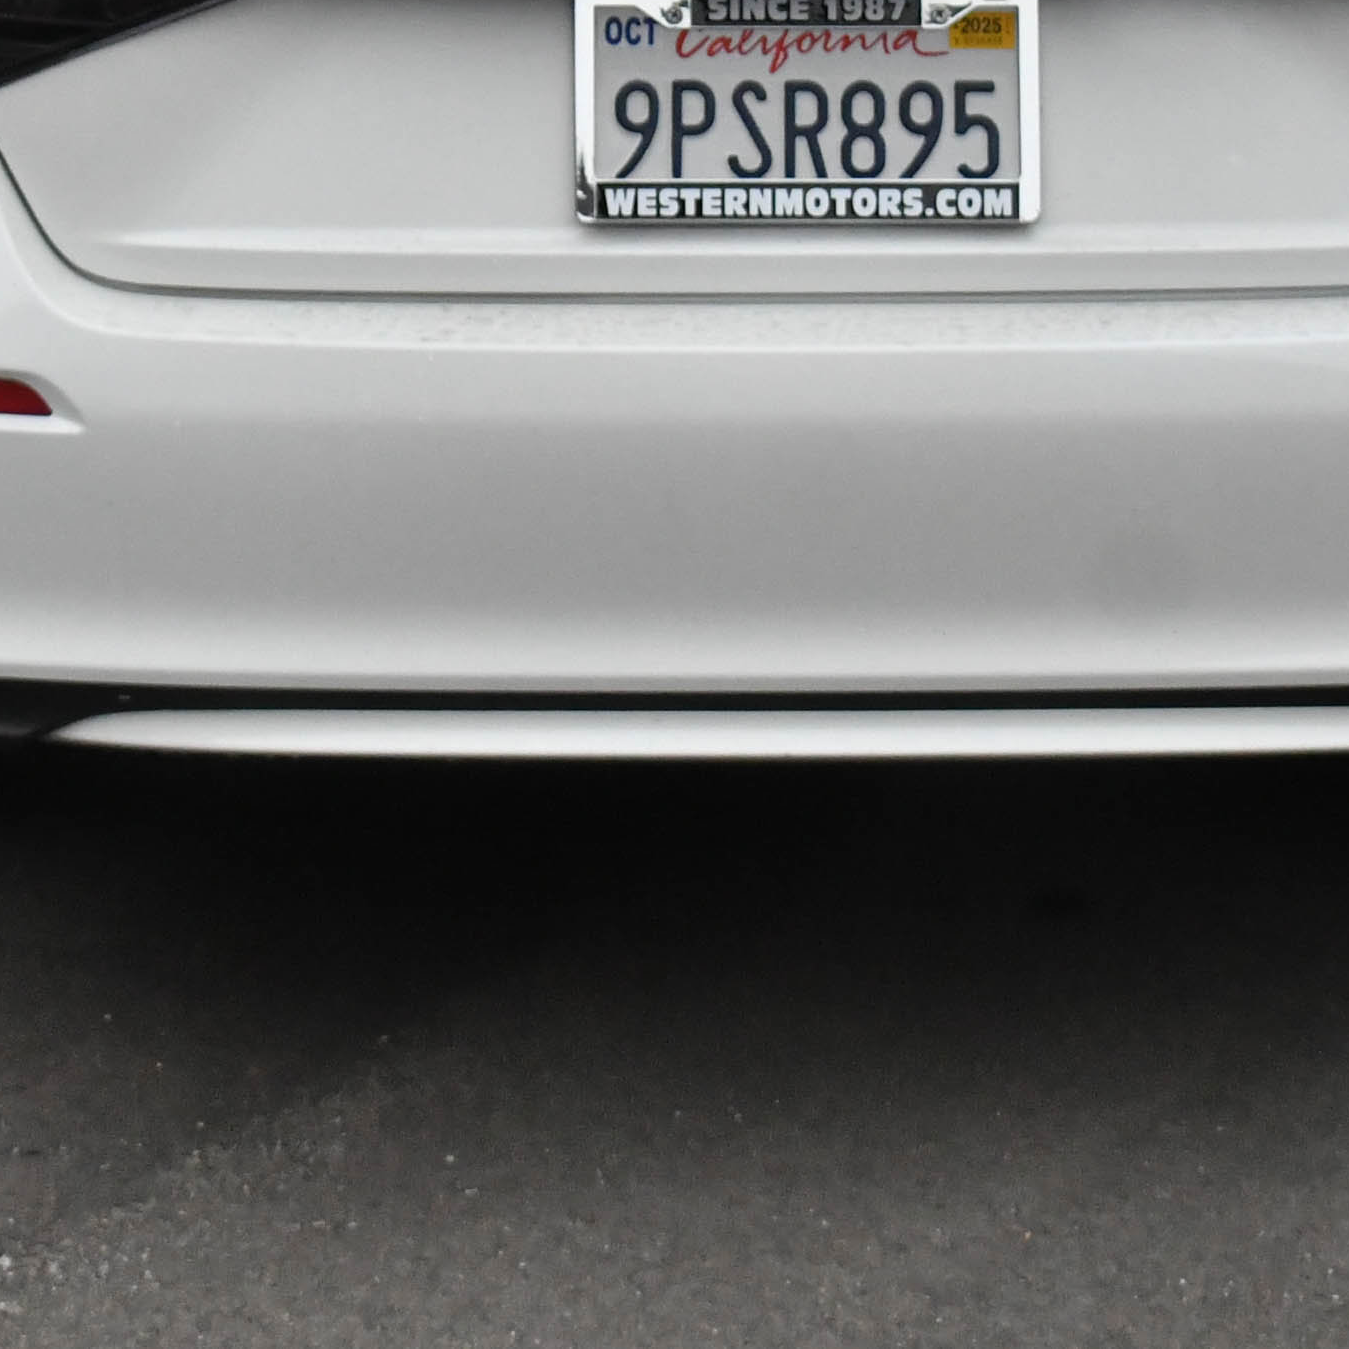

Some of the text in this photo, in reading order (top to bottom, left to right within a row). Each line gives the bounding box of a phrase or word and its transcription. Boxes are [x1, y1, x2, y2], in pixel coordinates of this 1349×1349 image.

[605, 16, 656, 46] OCT
[962, 16, 1002, 34] 2025
[614, 79, 1002, 179] 9PSR895
[604, 186, 1014, 217] WESTERNMOTORS.COM
